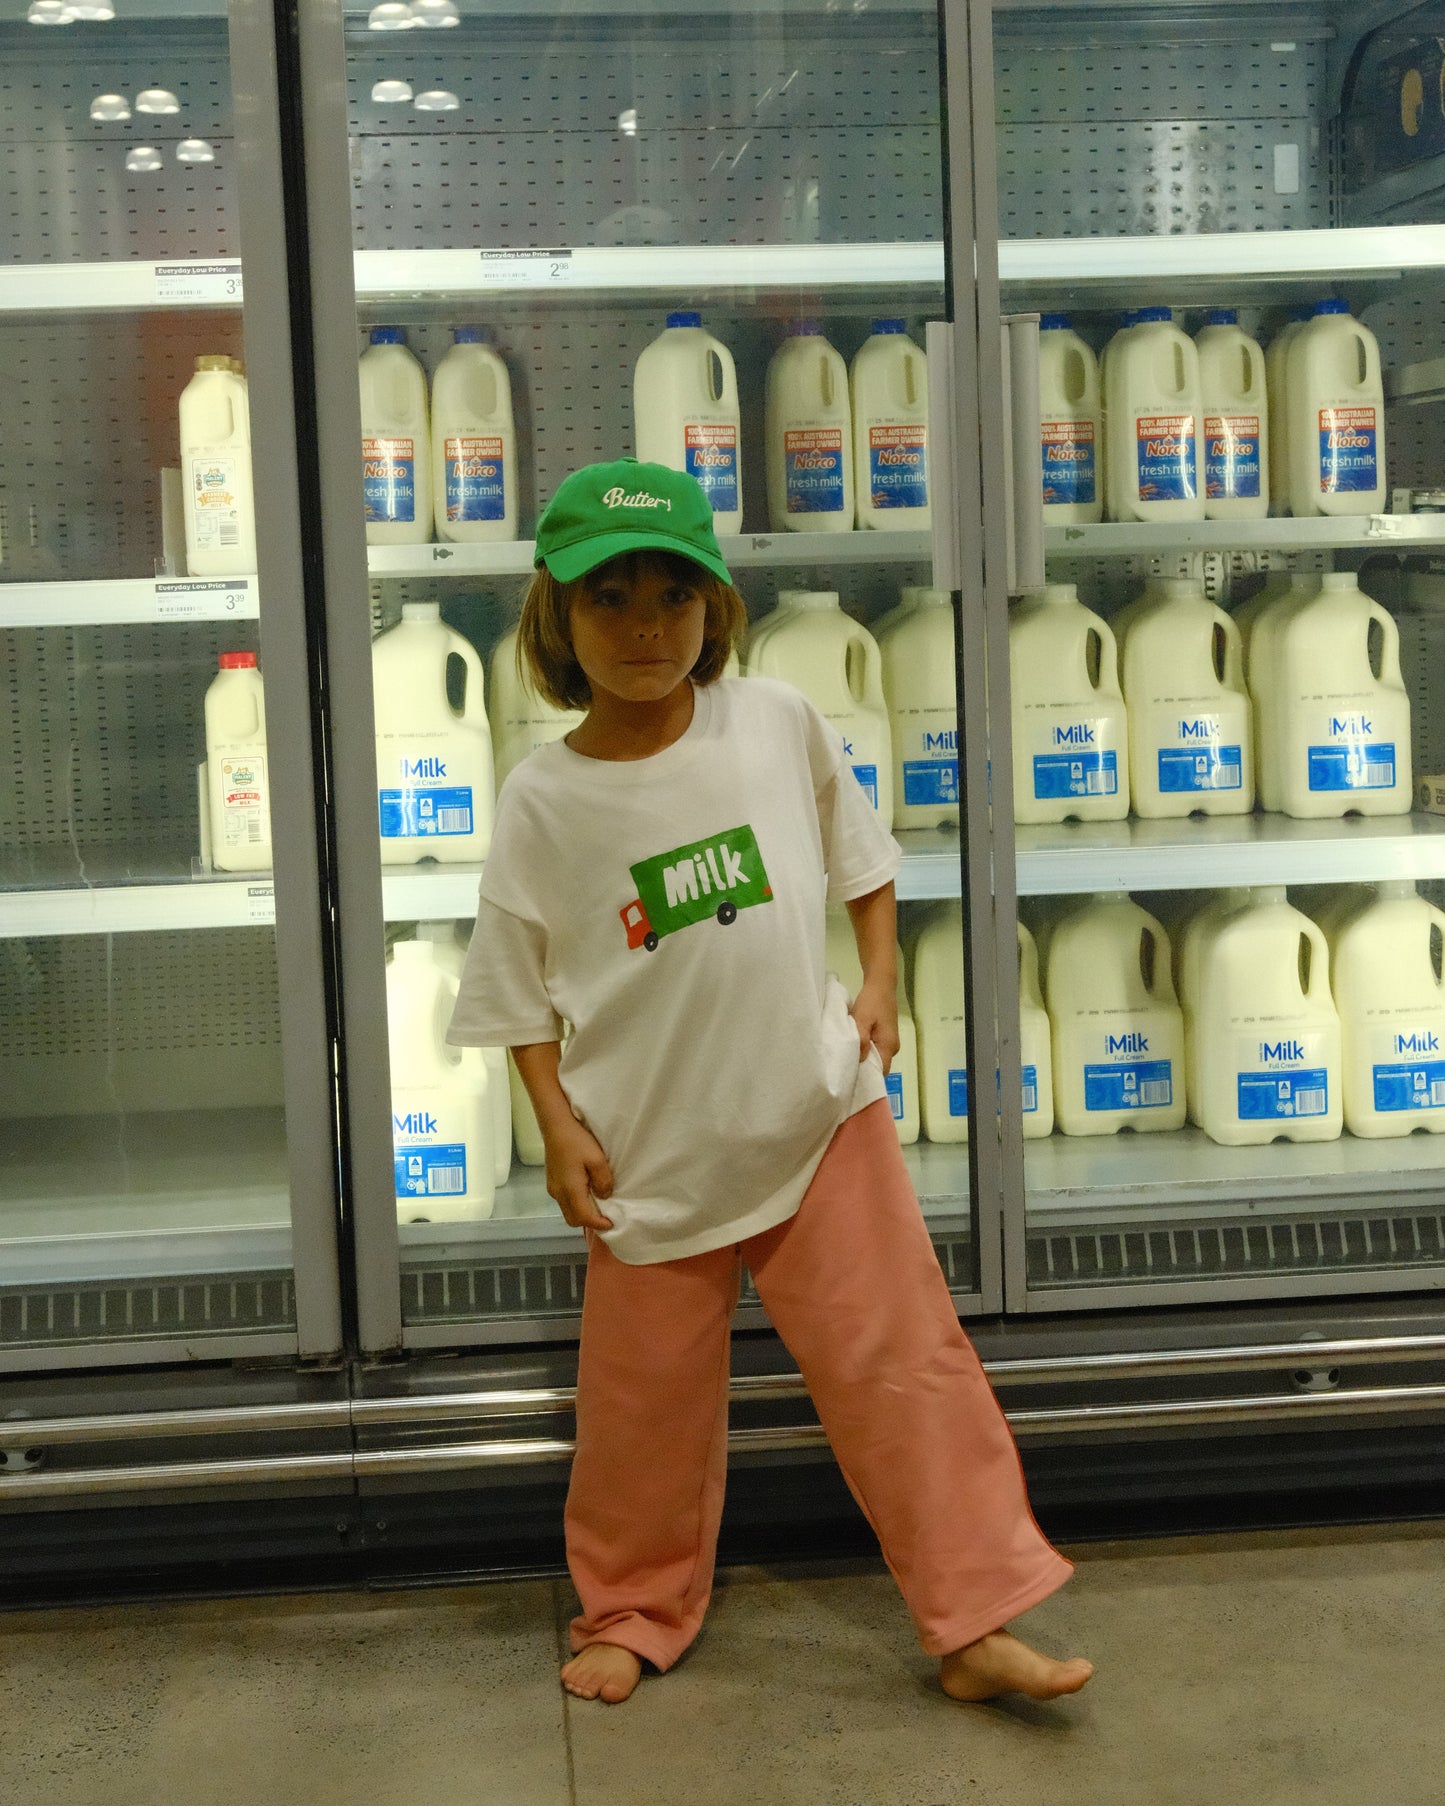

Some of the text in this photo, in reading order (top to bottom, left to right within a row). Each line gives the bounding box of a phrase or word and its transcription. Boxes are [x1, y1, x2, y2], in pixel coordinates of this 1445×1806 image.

[1338, 409, 1374, 418] AUSTRALIAN
[1057, 423, 1093, 431] AUSTRALIAN
[1140, 420, 1156, 428] 100%
[1350, 418, 1374, 426] OWNED
[804, 431, 840, 440] AUSTRALIAN
[1140, 428, 1168, 436] FARMER
[463, 439, 501, 448] AUSTRALIAN
[787, 441, 815, 449] FARMER
[872, 437, 900, 445] FARMER
[1328, 432, 1369, 448] Norco
[694, 450, 731, 467] Norco
[878, 449, 919, 466] Norco
[1047, 445, 1088, 462] Norco
[1353, 454, 1375, 465] milk
[794, 453, 836, 470] Norco
[453, 461, 496, 478] Norco
[1071, 467, 1094, 478] milk
[1140, 464, 1170, 475] fresh
[1237, 463, 1259, 473] milk
[718, 474, 736, 485] milk
[789, 475, 842, 488] fresh milk
[873, 471, 926, 484] fresh milk
[448, 484, 503, 496] fresh milk
[602, 486, 671, 512] Buttery
[1056, 724, 1094, 745] Milk
[404, 757, 447, 778] Milk
[663, 843, 751, 909] Milk
[1109, 1032, 1149, 1054] Milk
[1398, 1031, 1439, 1053] Milk
[1264, 1040, 1304, 1062] Milk
[393, 1112, 438, 1135] Milk
[410, 1135, 433, 1143] Cream
